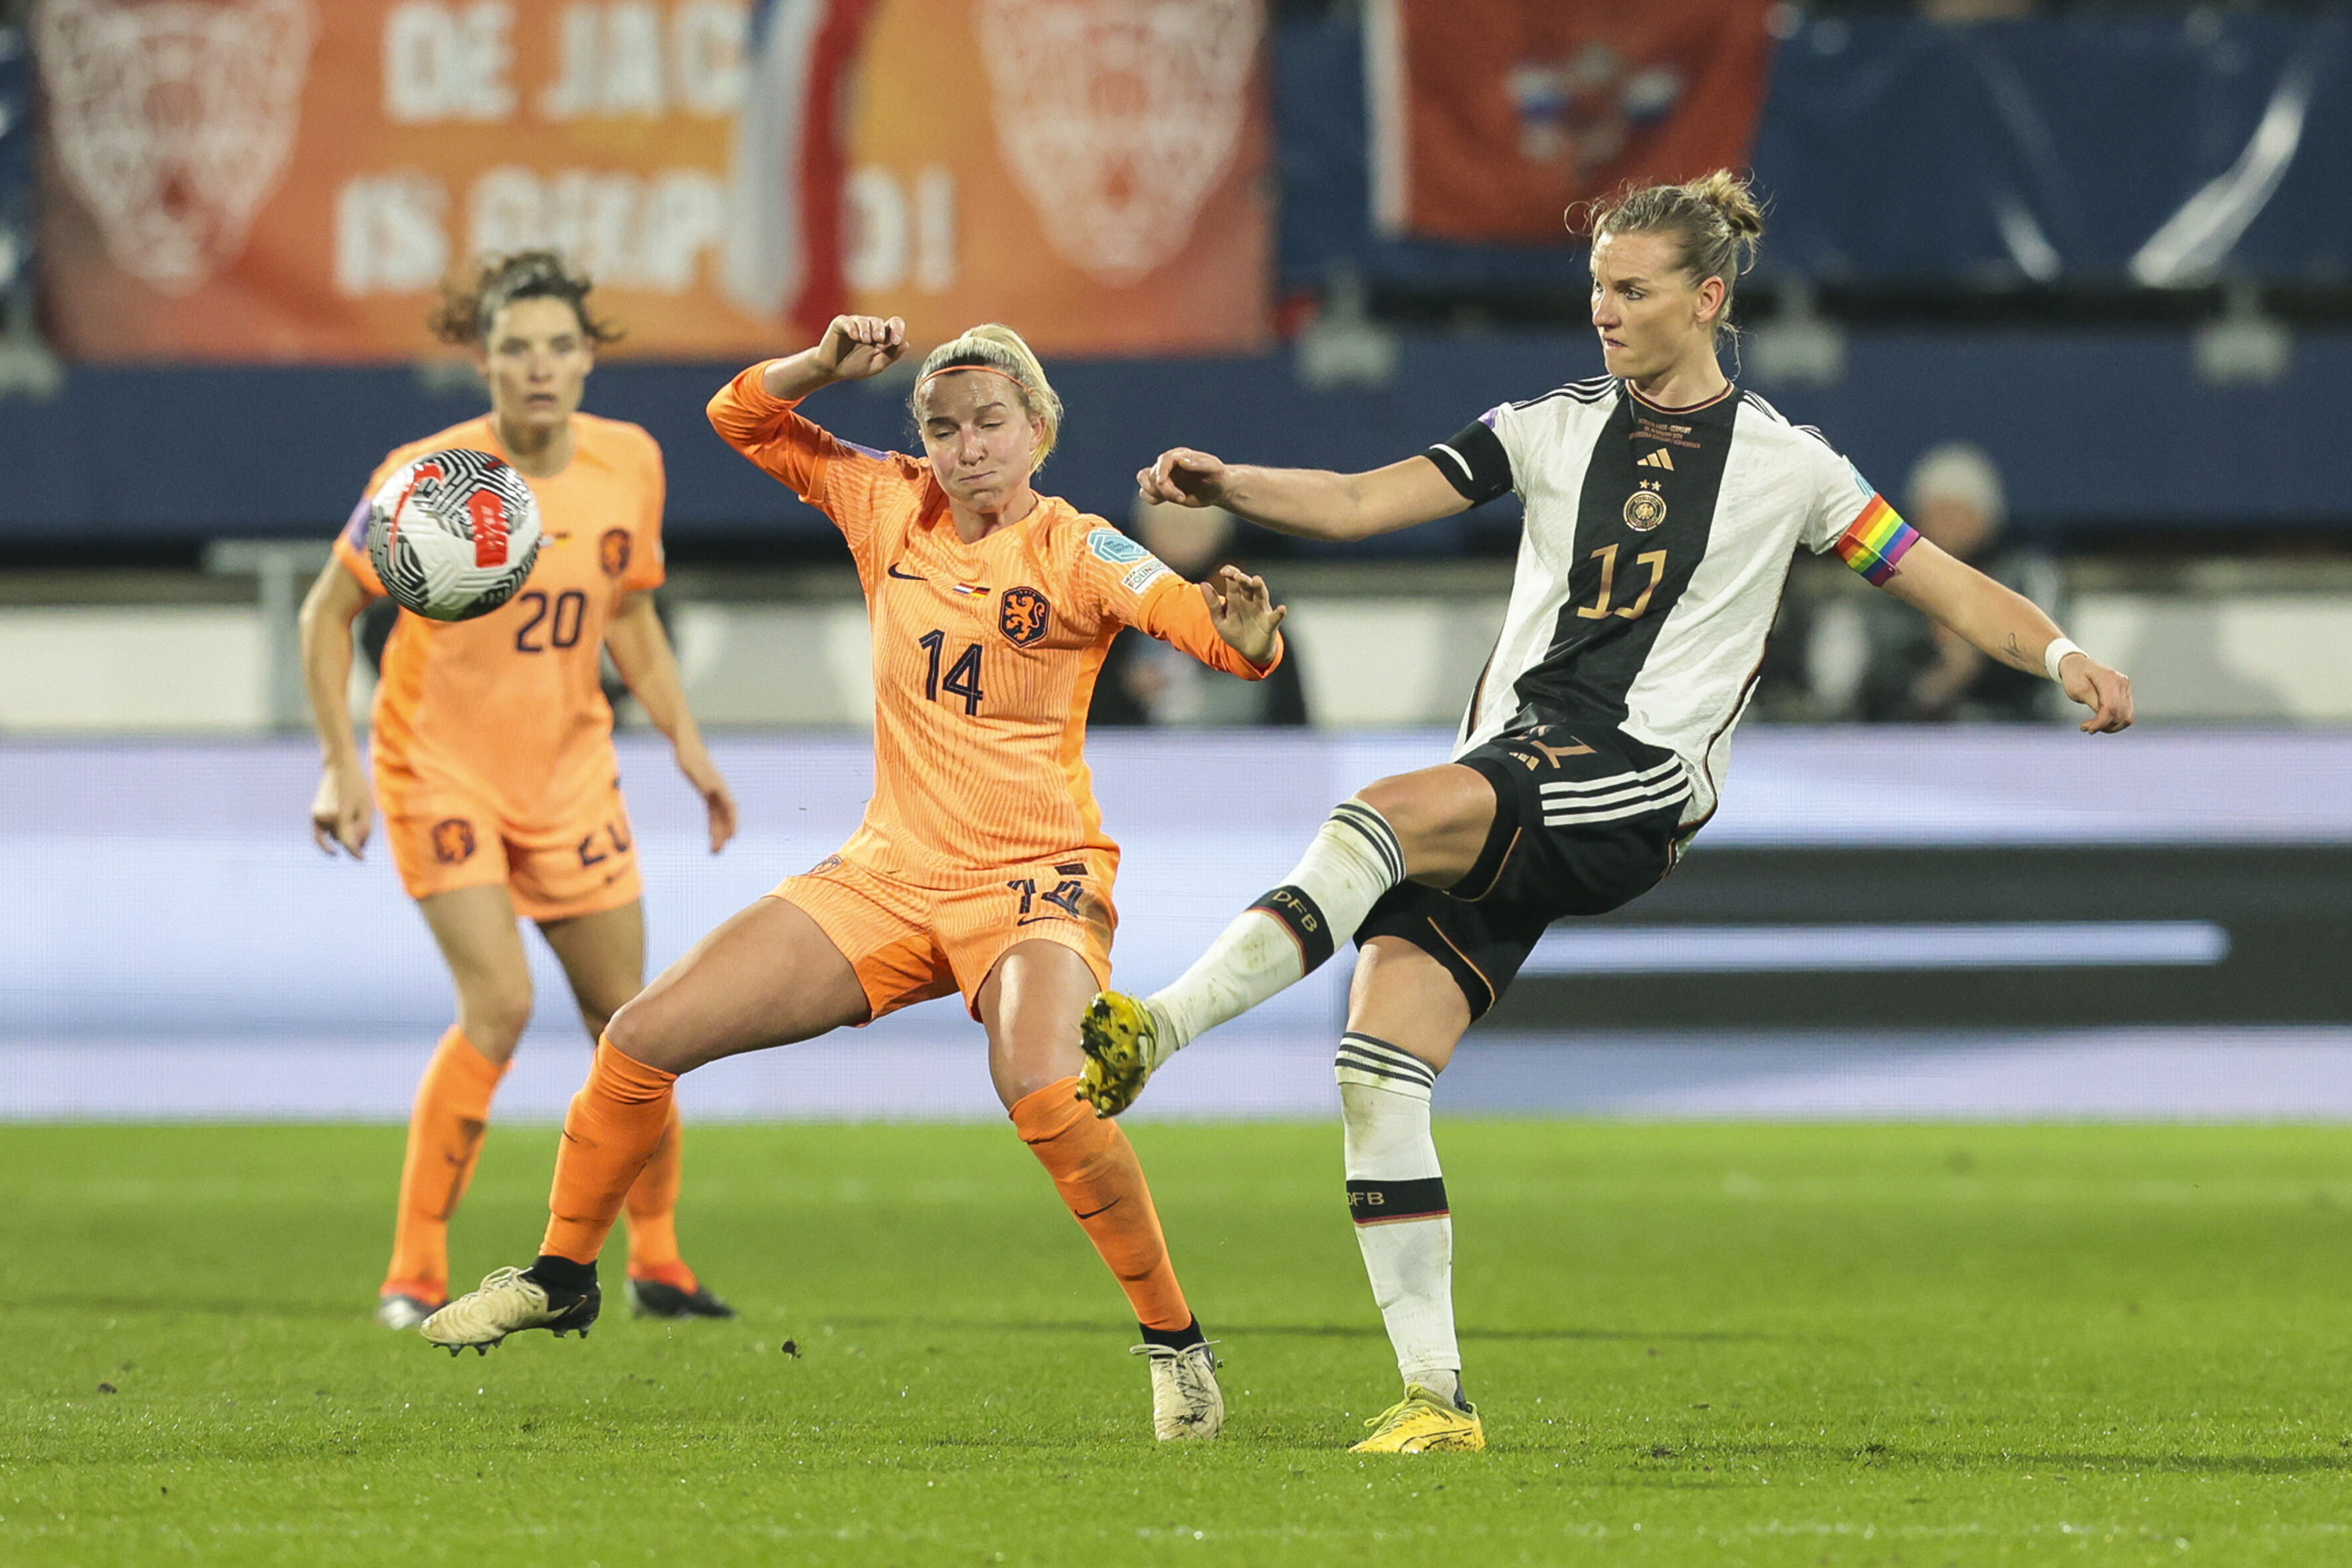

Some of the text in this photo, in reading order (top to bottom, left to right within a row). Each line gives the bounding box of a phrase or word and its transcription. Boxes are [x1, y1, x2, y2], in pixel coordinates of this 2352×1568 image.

[384, 0, 749, 121] DE JAC
[1577, 543, 1667, 619] 17
[517, 591, 585, 652] 20
[918, 629, 983, 716] 14
[1007, 879, 1084, 919] 14
[1272, 890, 1318, 932] DFB
